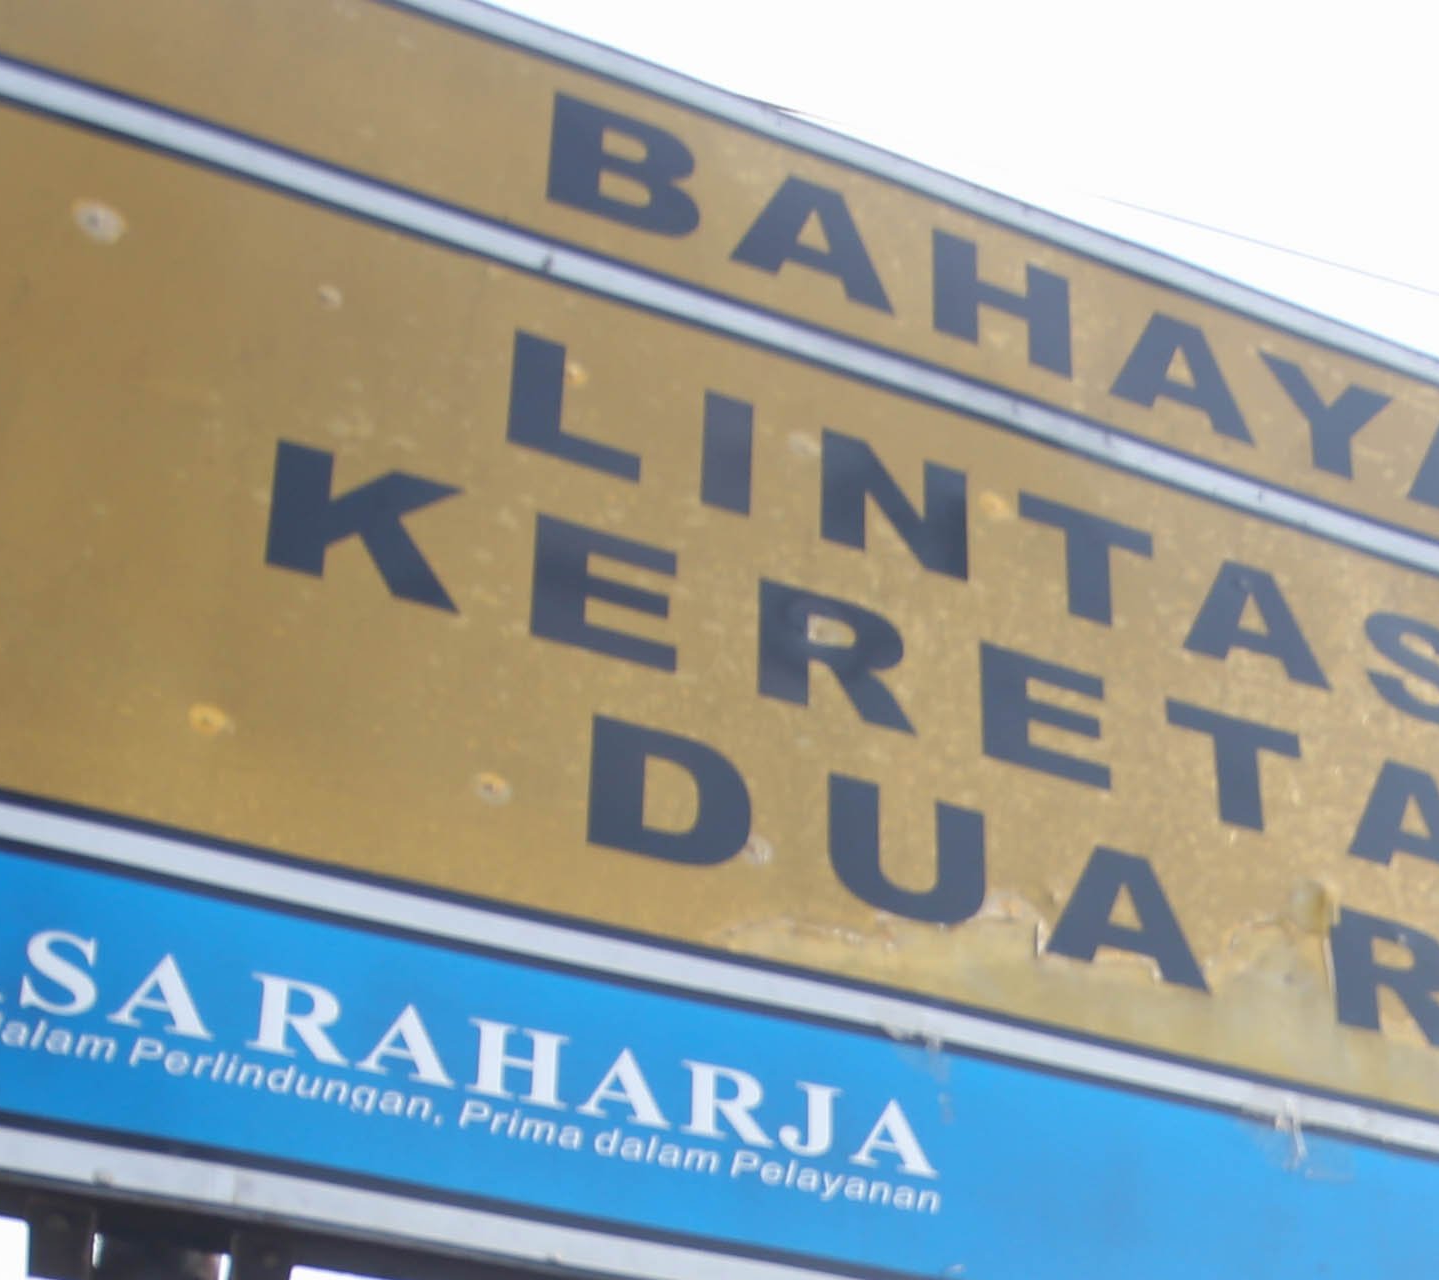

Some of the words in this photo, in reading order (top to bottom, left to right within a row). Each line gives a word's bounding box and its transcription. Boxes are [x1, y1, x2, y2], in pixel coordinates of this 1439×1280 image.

[587, 713, 1210, 995] DUA
[128, 1036, 447, 1128] Perlindungan,
[459, 1098, 584, 1155] Prima
[594, 1121, 721, 1177] dalam
[730, 1149, 942, 1215] Pelayanan
[246, 971, 941, 1180] RAHARJA
